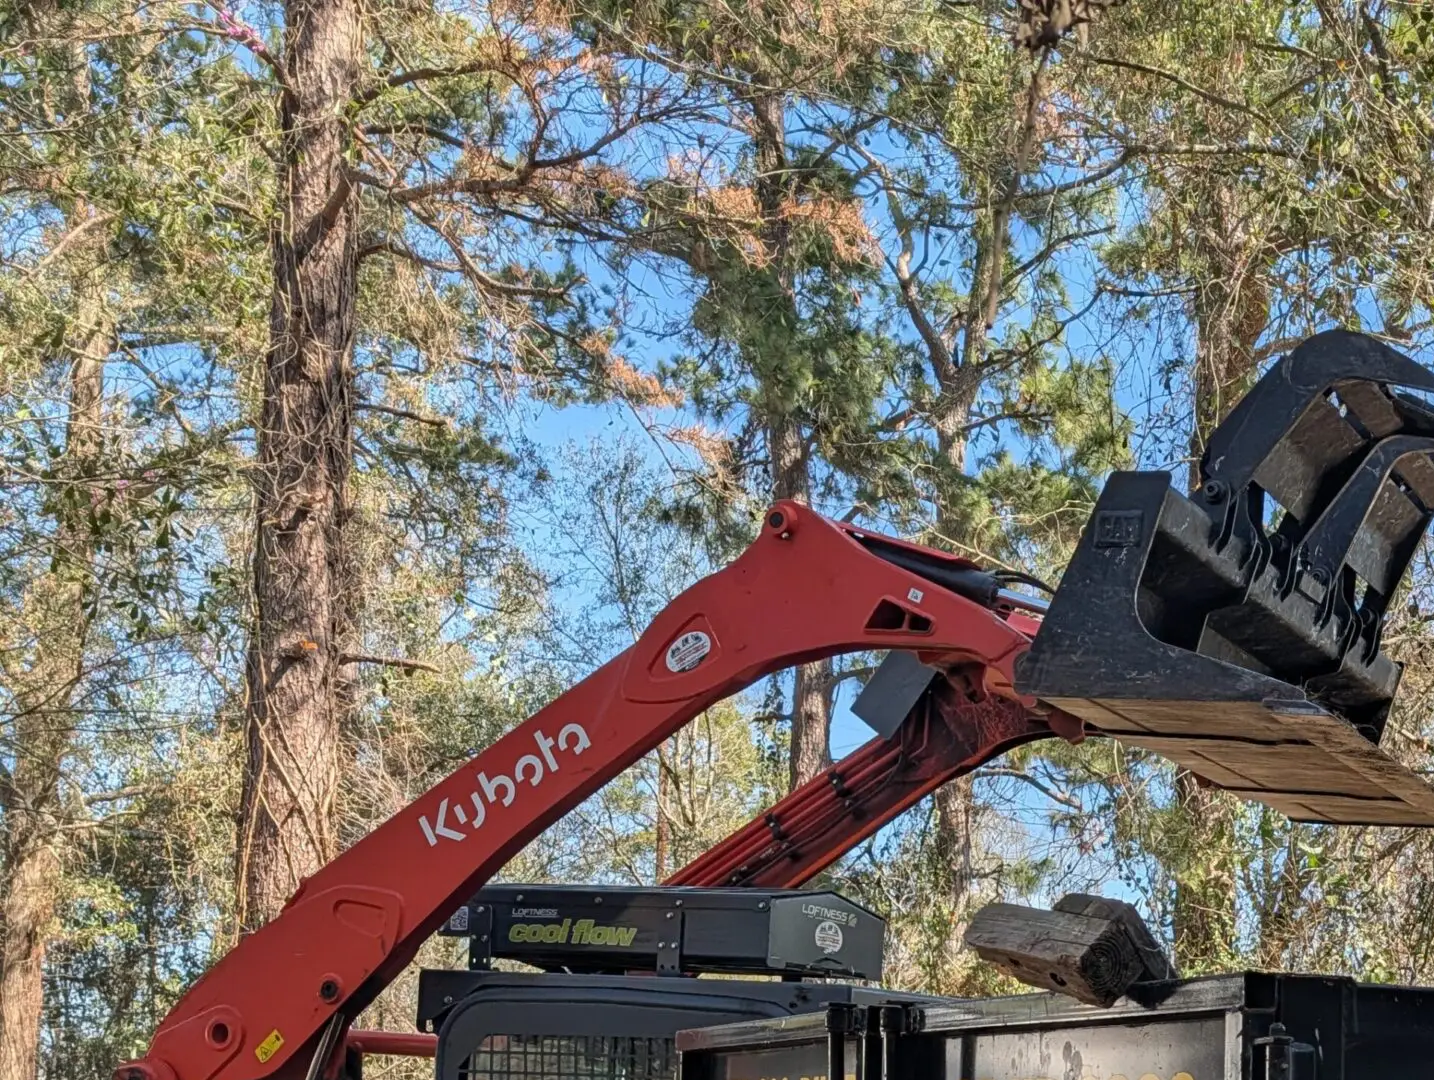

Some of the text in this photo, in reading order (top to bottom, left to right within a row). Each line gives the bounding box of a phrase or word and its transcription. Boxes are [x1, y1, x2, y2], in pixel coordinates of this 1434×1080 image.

[418, 723, 591, 847] Kubota
[511, 907, 559, 917] LOFTNESS
[802, 903, 848, 922] LOFTNESS
[508, 918, 638, 947] cool flow
